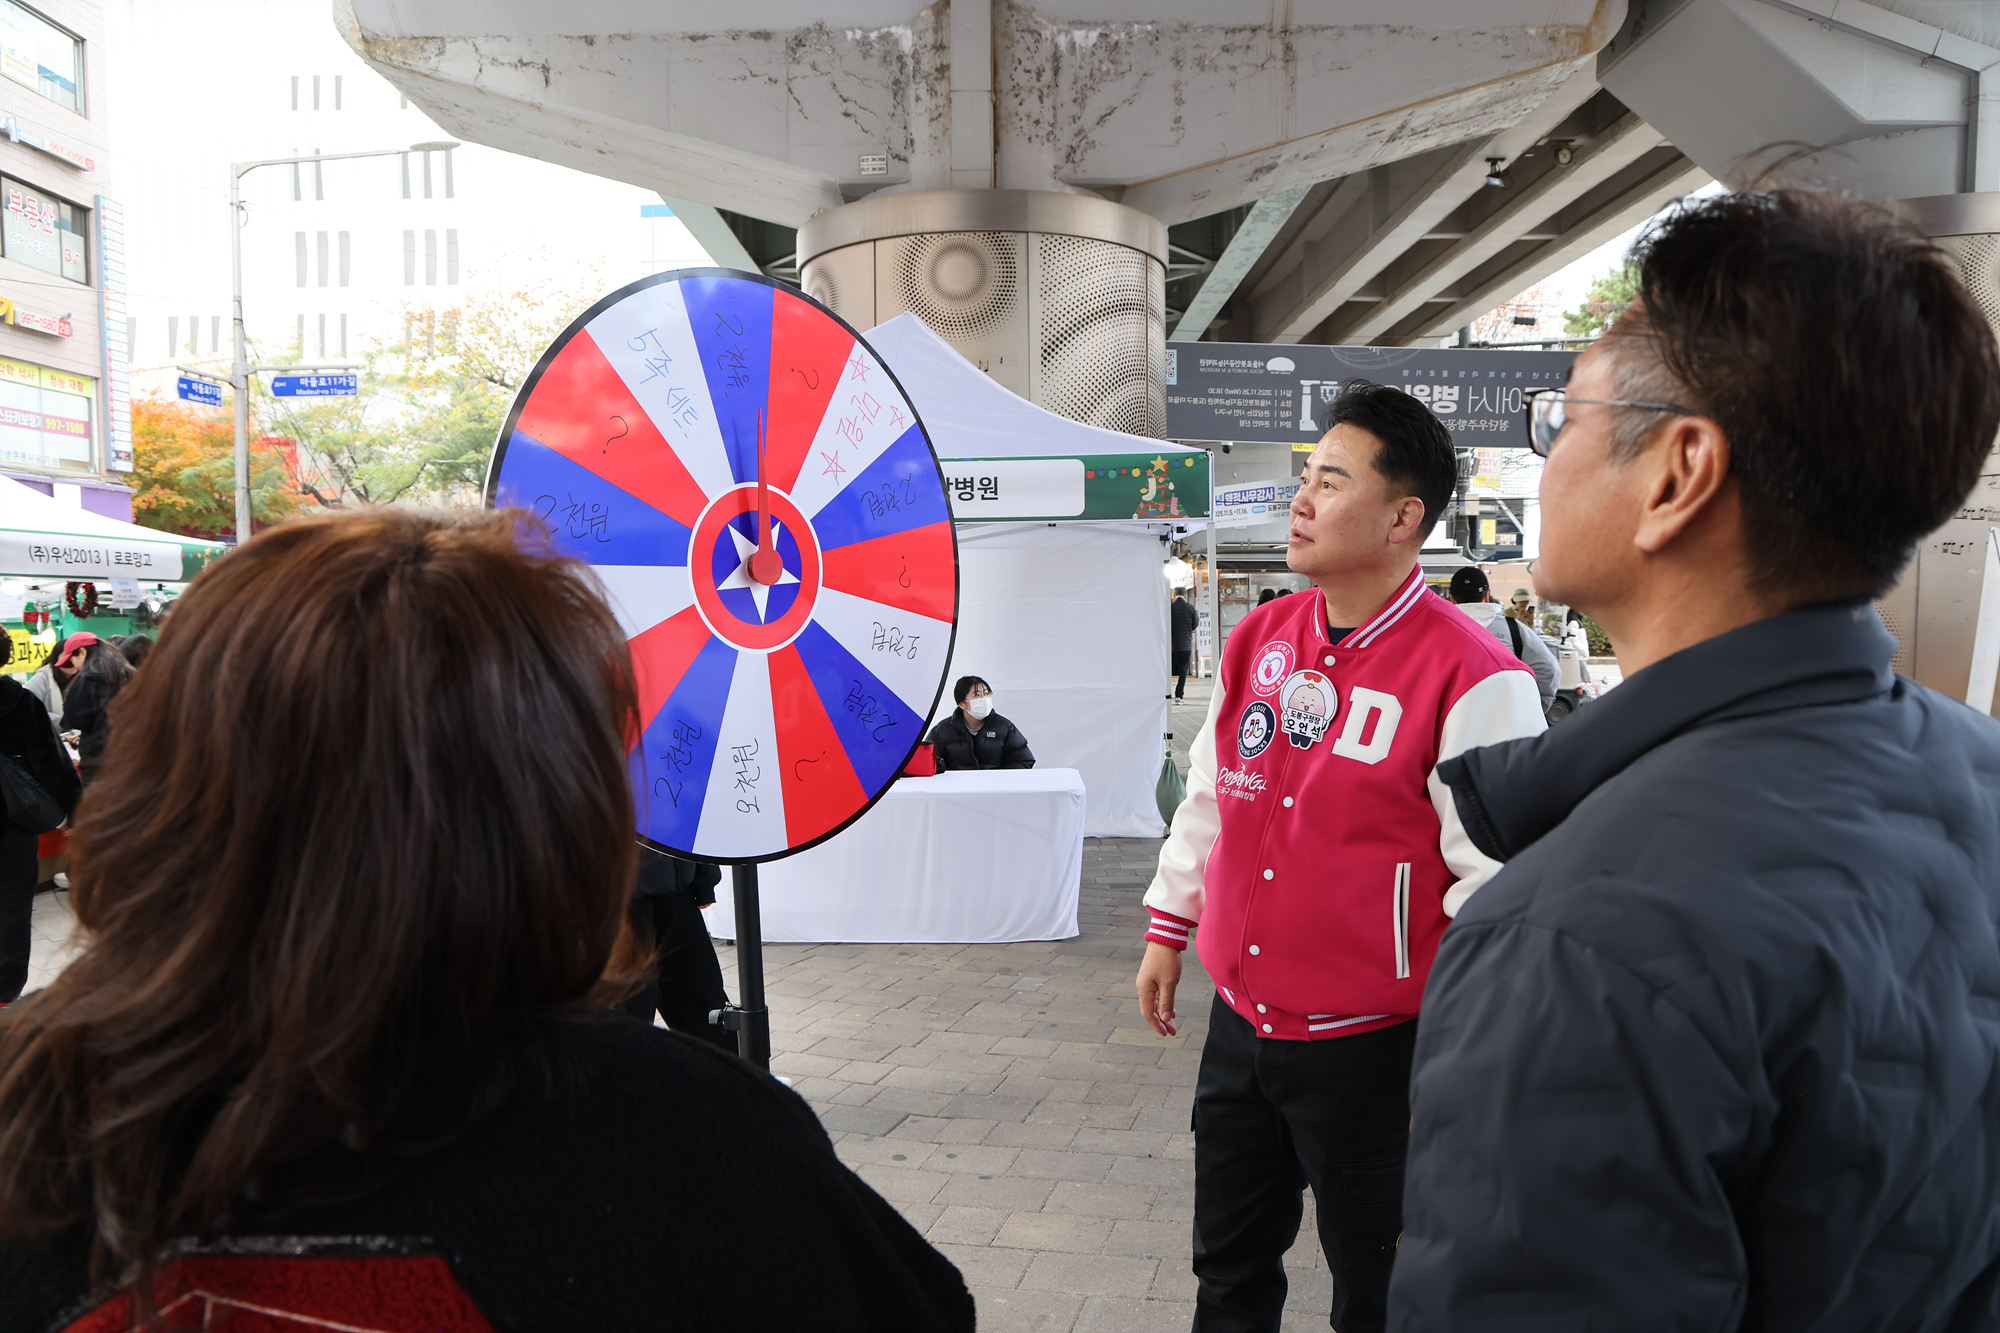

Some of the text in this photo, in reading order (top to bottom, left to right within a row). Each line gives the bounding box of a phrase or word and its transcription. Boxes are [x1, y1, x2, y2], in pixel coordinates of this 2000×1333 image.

[9, 190, 54, 234] 부동산
[11, 233, 55, 257] 997-4300
[21, 312, 57, 332] 997-1580
[300, 376, 356, 387] 마들로11가길
[45, 417, 85, 435] 997-1580
[1224, 488, 1274, 504] 행정사무감사
[28, 545, 153, 567] (주)우신2013 로로망고
[1251, 705, 1267, 713] SEOUL
[1291, 710, 1321, 725] 도봉구청장
[1332, 686, 1403, 765] D
